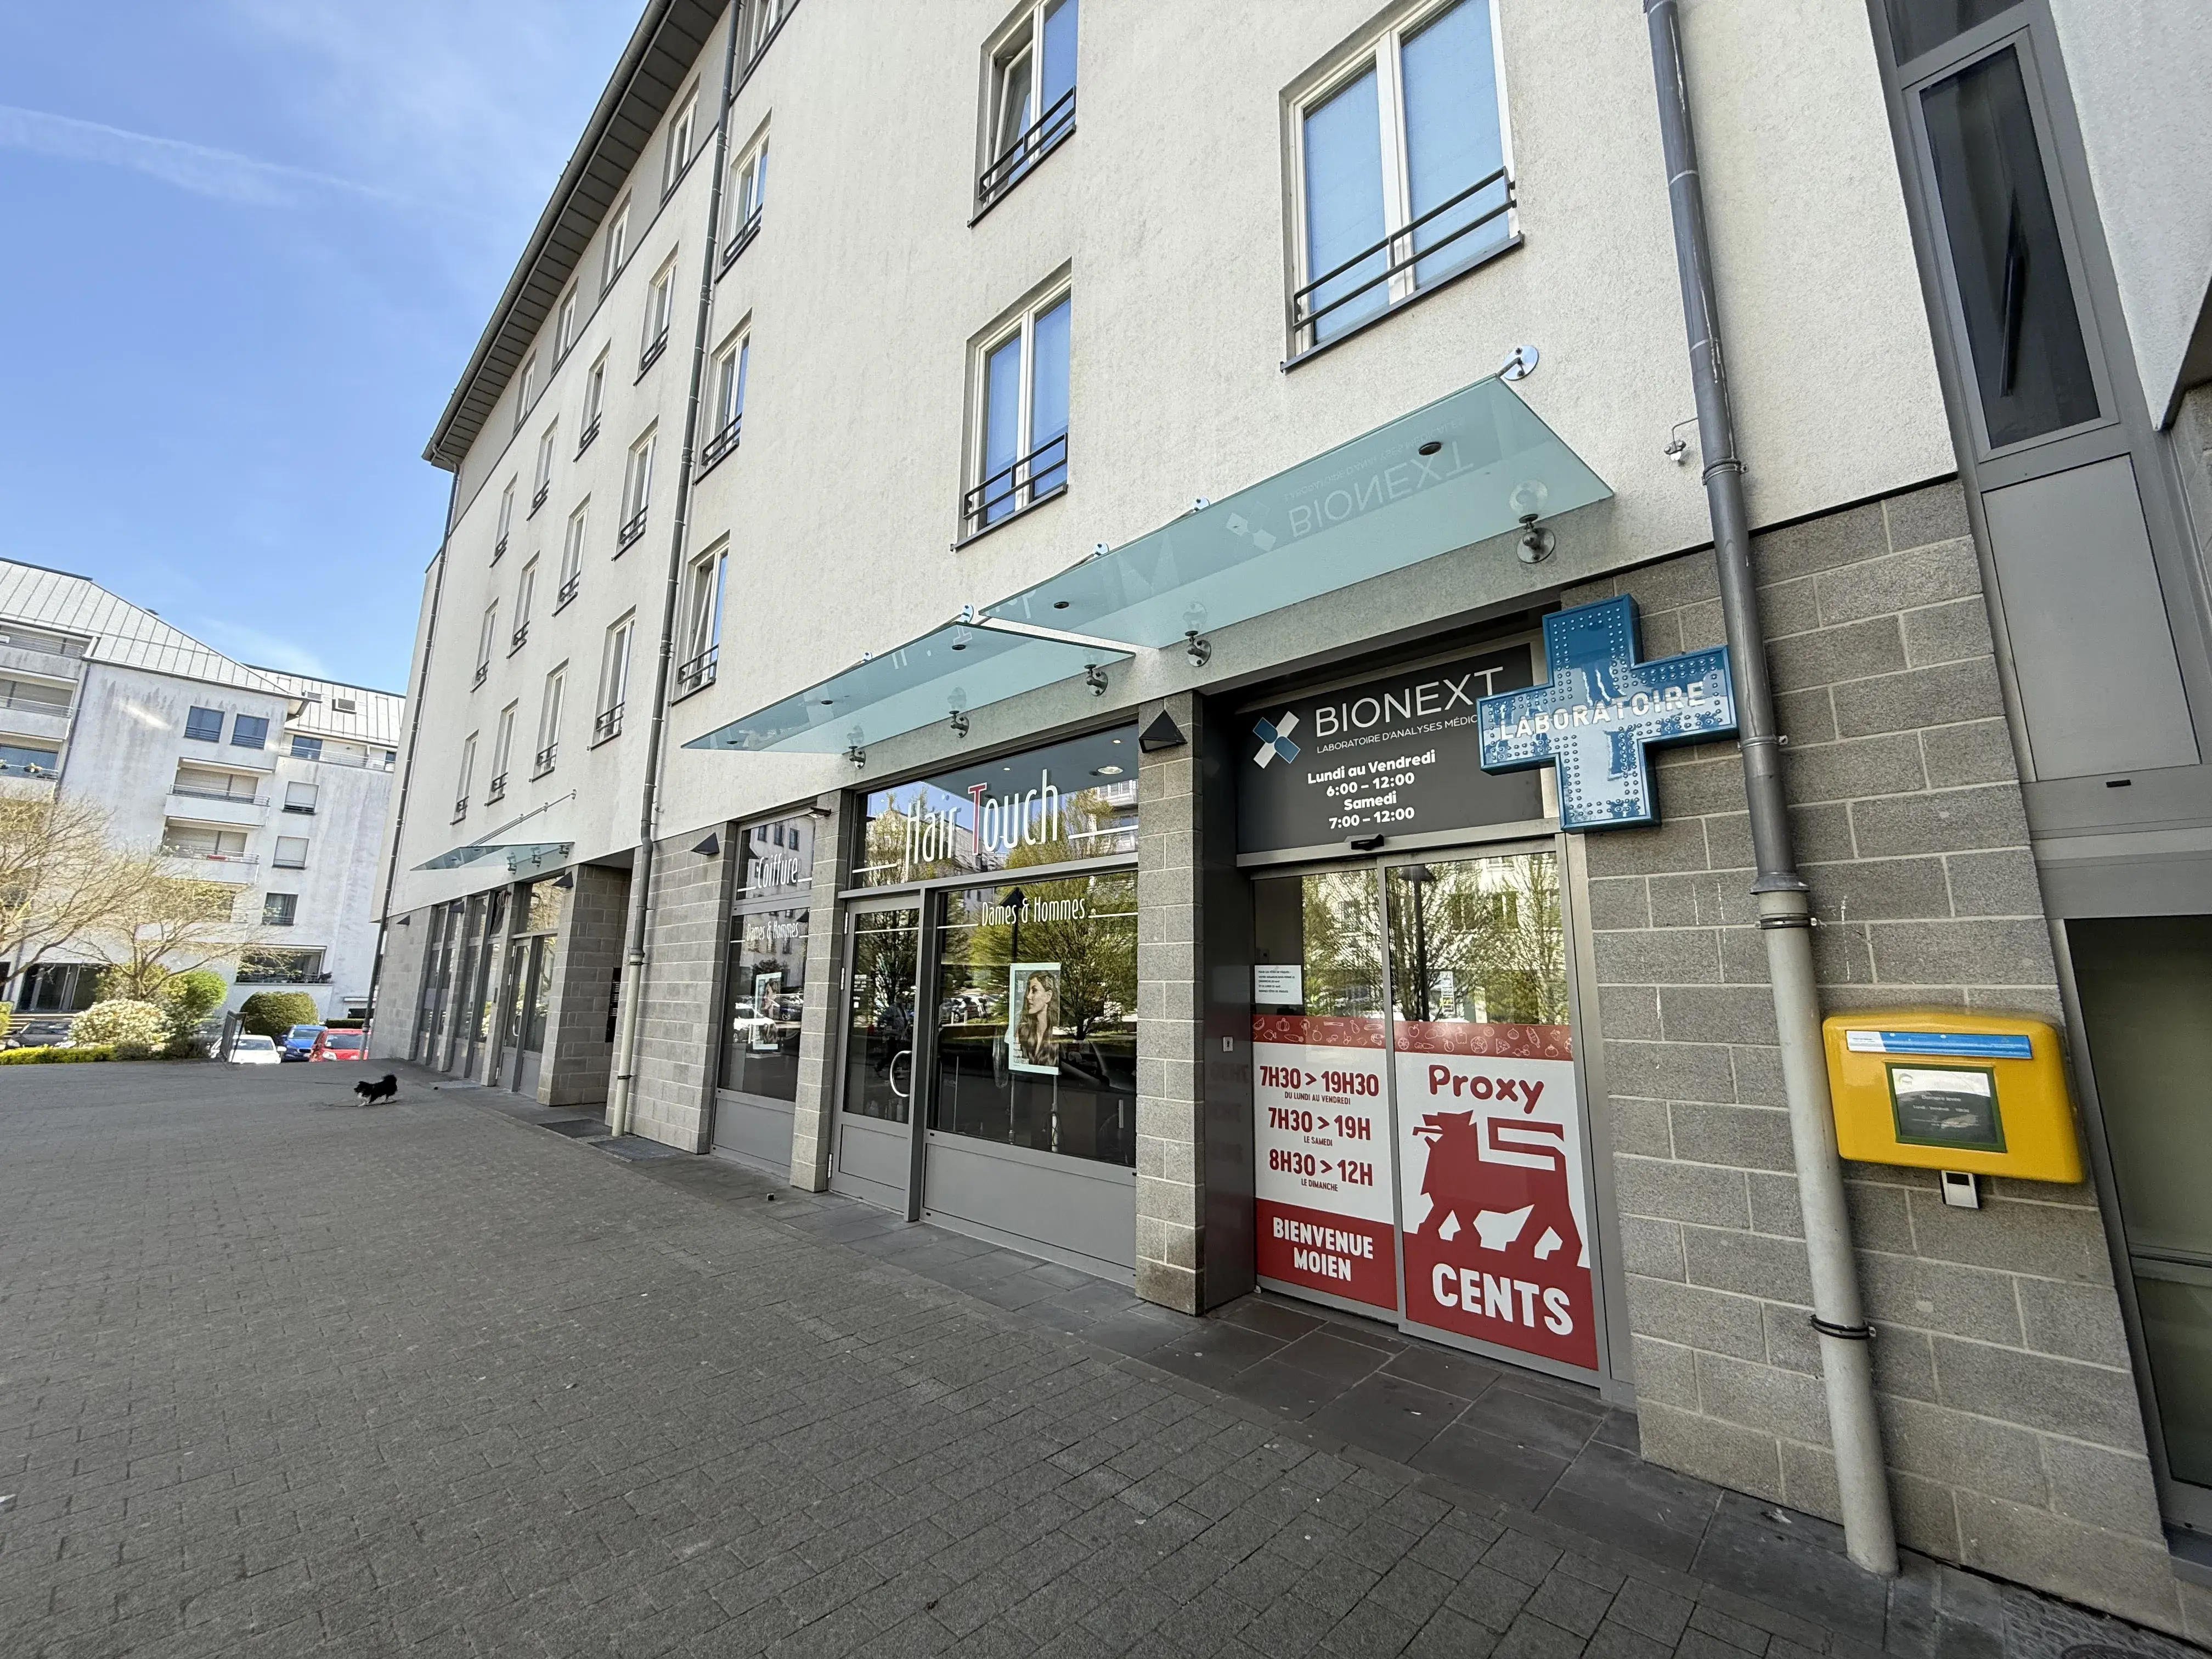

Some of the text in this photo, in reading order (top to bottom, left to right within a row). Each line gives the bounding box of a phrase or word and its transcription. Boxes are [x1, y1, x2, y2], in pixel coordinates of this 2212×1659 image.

[1316, 666, 1504, 737] BIONEXT
[1500, 682, 1707, 740] LABORATOIRE
[1317, 714, 1478, 754] LABORATOIRE D'ANALYSES MÉDIC
[1307, 749, 1436, 785] Lundi au Vendredi
[1326, 782, 1358, 797] 6:00
[1373, 772, 1415, 789] 12:00
[1329, 815, 1360, 829] 7:00
[1373, 807, 1415, 823] 12:00
[1344, 790, 1397, 811] Samedi
[904, 769, 1058, 882] Hair Touch
[758, 853, 798, 889] Coiffure
[981, 896, 1085, 927] Dames & Hommes
[747, 923, 765, 941] Dames
[773, 920, 799, 939] Hommes
[1260, 1065, 1301, 1089] 7H30
[1321, 1070, 1379, 1097] 19H30
[1294, 1092, 1311, 1101] LUNDI
[1312, 1094, 1320, 1102] AU
[1321, 1094, 1351, 1105] VENDREDI
[1429, 1064, 1544, 1114] Proxy
[1268, 1107, 1313, 1133] 7H30
[1334, 1115, 1371, 1141] 19H
[1304, 1135, 1333, 1147] LE SAMEDI
[1269, 1149, 1316, 1176] 8H30
[1337, 1159, 1373, 1187] 12H
[1301, 1178, 1339, 1192] LE DIMANCHE
[1273, 1216, 1374, 1259] BIENVENUE
[1294, 1246, 1352, 1282] MOIEN
[1432, 1263, 1573, 1336] CENTS
